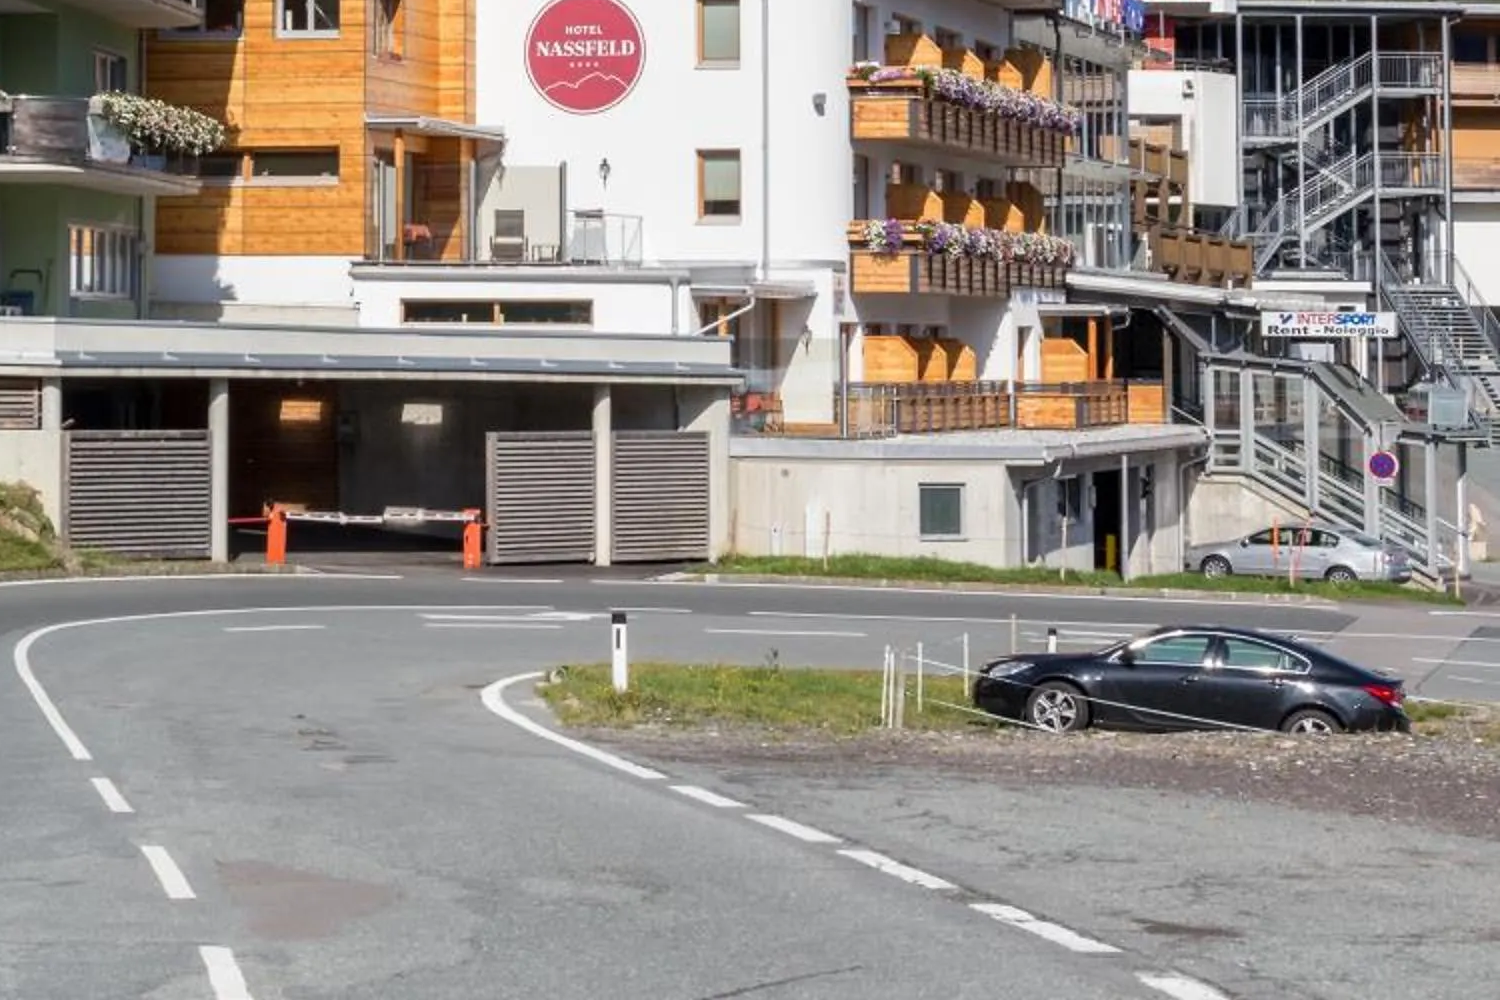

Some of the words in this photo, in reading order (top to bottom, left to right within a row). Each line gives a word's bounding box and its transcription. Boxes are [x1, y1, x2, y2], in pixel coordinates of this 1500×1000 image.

[565, 25, 603, 35] HOTEL
[535, 39, 636, 57] NASSFELD
[1297, 313, 1376, 325] INTERSPORT
[1268, 325, 1308, 334] Rent
[1324, 325, 1389, 336] Noleggio
